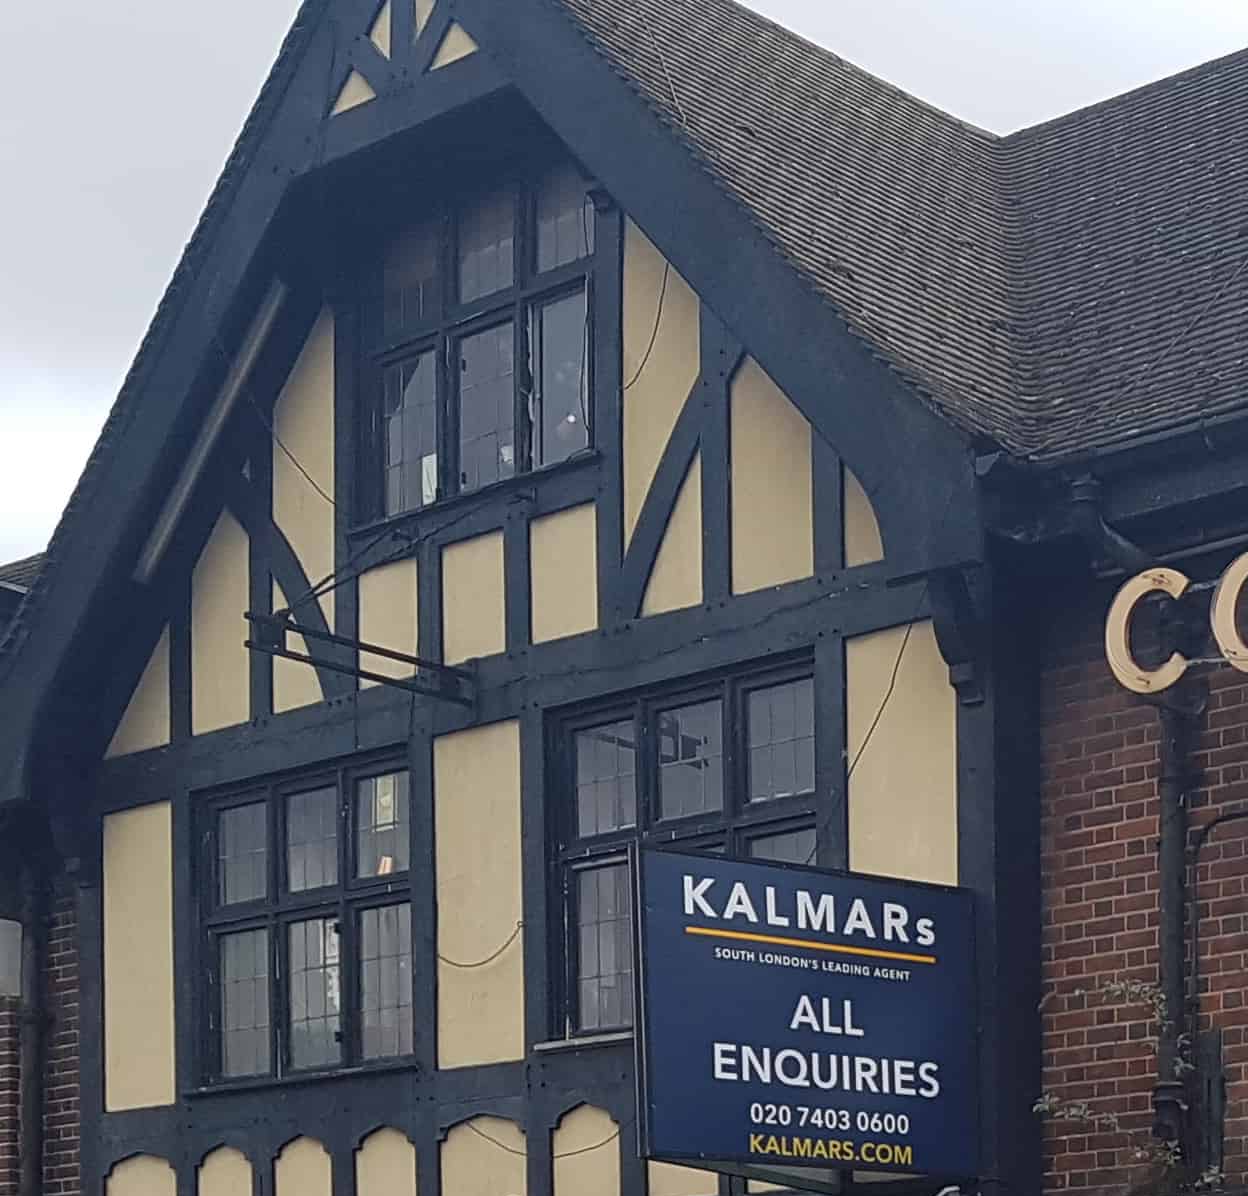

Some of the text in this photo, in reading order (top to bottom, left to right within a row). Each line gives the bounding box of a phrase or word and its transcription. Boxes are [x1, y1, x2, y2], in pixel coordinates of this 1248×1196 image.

[715, 946, 910, 981] SOUTH LONDON'S LEADING AGENT
[790, 995, 864, 1036] ALL
[712, 1042, 940, 1098] ENQUIRIES
[750, 1103, 910, 1134] 020 7403 0600
[749, 1133, 912, 1165] KALMARS.COM
